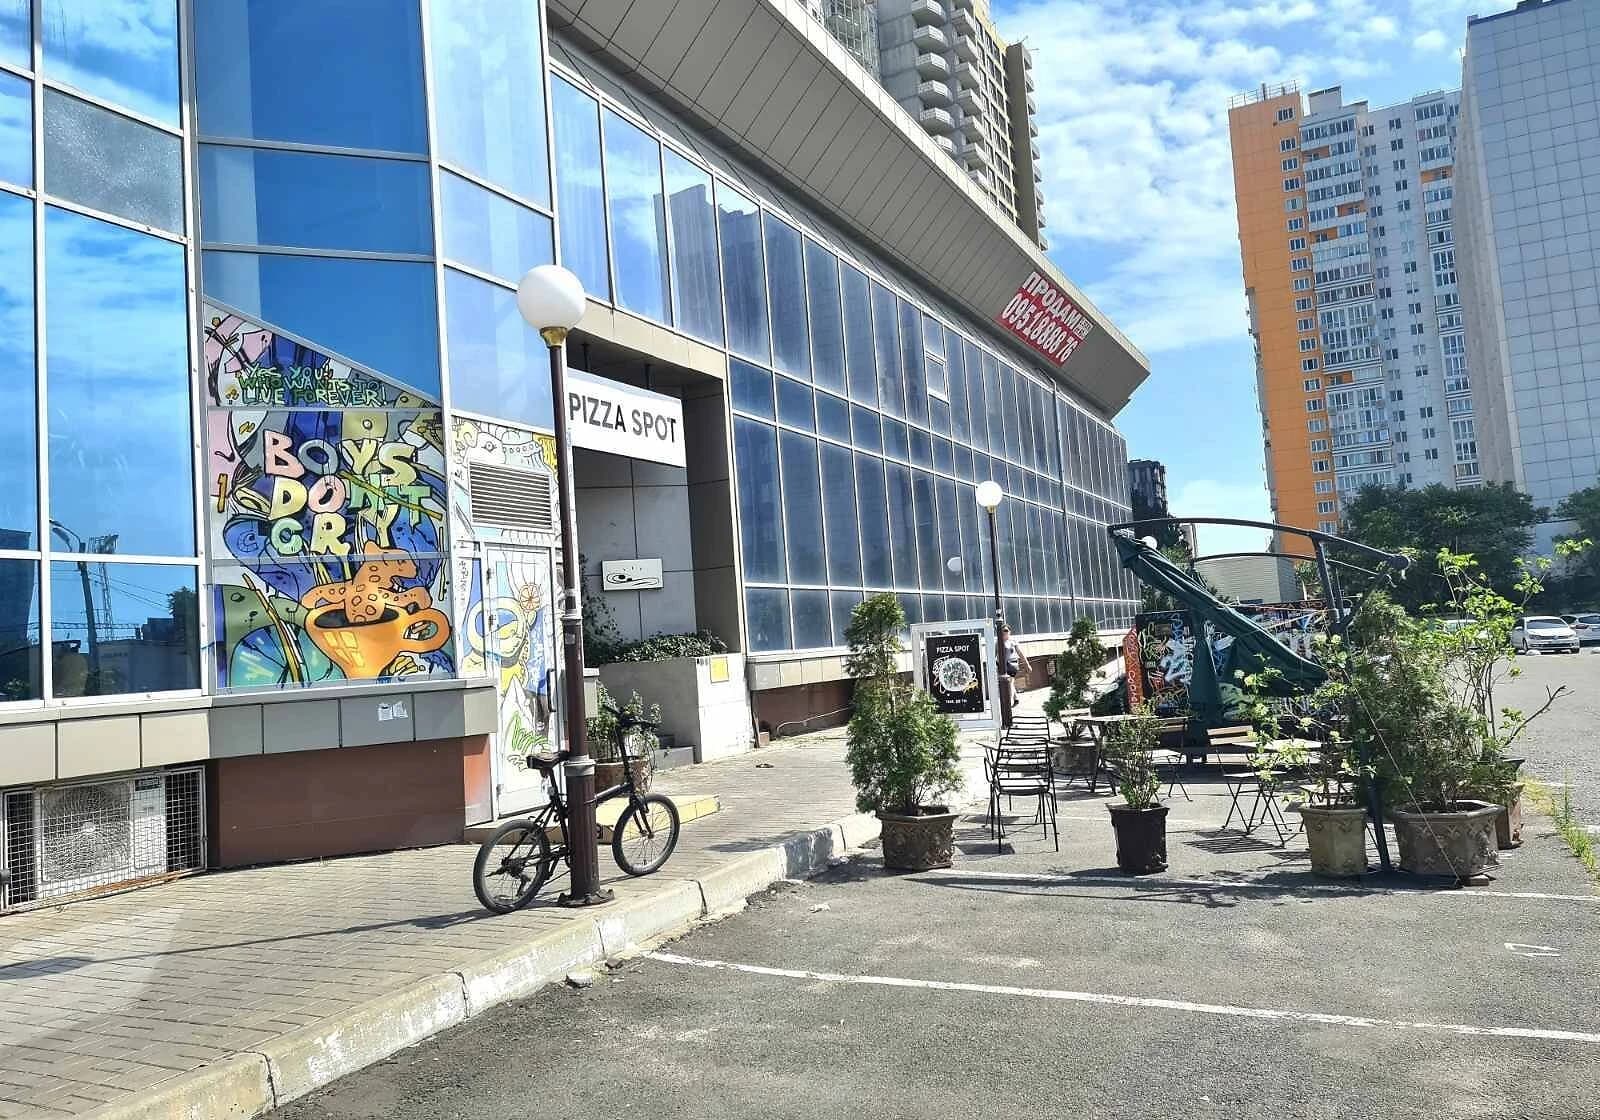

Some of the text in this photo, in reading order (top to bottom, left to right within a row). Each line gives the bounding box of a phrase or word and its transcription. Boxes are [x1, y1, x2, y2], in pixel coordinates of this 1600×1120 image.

[1022, 272, 1082, 329] ПРОДАМ
[238, 374, 282, 391] WHO
[284, 376, 351, 392] WANTS
[242, 384, 387, 406] LIVE FOREVER!
[569, 392, 676, 443] PIZZA SPOT
[263, 428, 418, 486] BOYS
[270, 503, 401, 556] CRY
[936, 645, 953, 654] PIZZA
